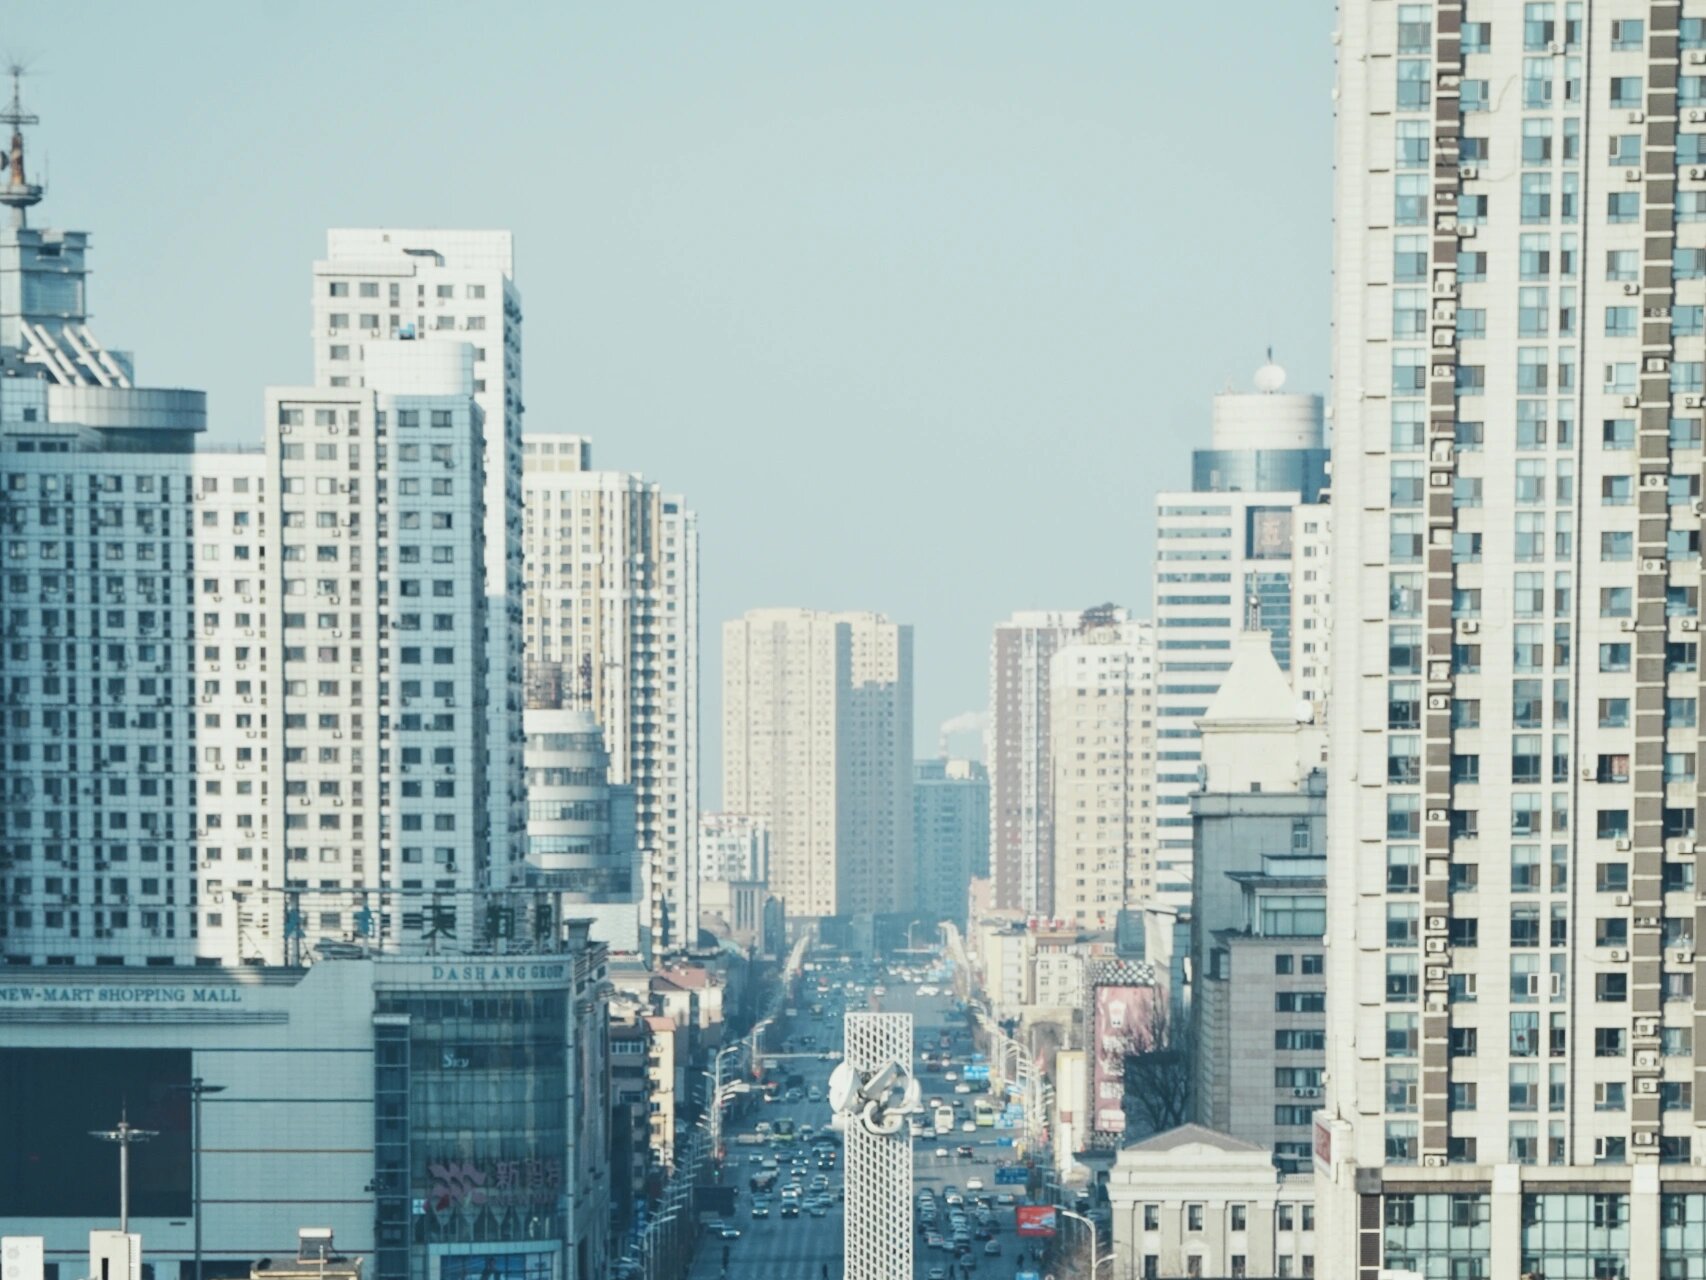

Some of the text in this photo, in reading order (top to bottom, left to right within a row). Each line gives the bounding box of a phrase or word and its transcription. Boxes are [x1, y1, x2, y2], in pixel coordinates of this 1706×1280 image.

[432, 965, 526, 980] DASHANG
[0, 987, 242, 1002] NEW-MART SHOPPING MALL
